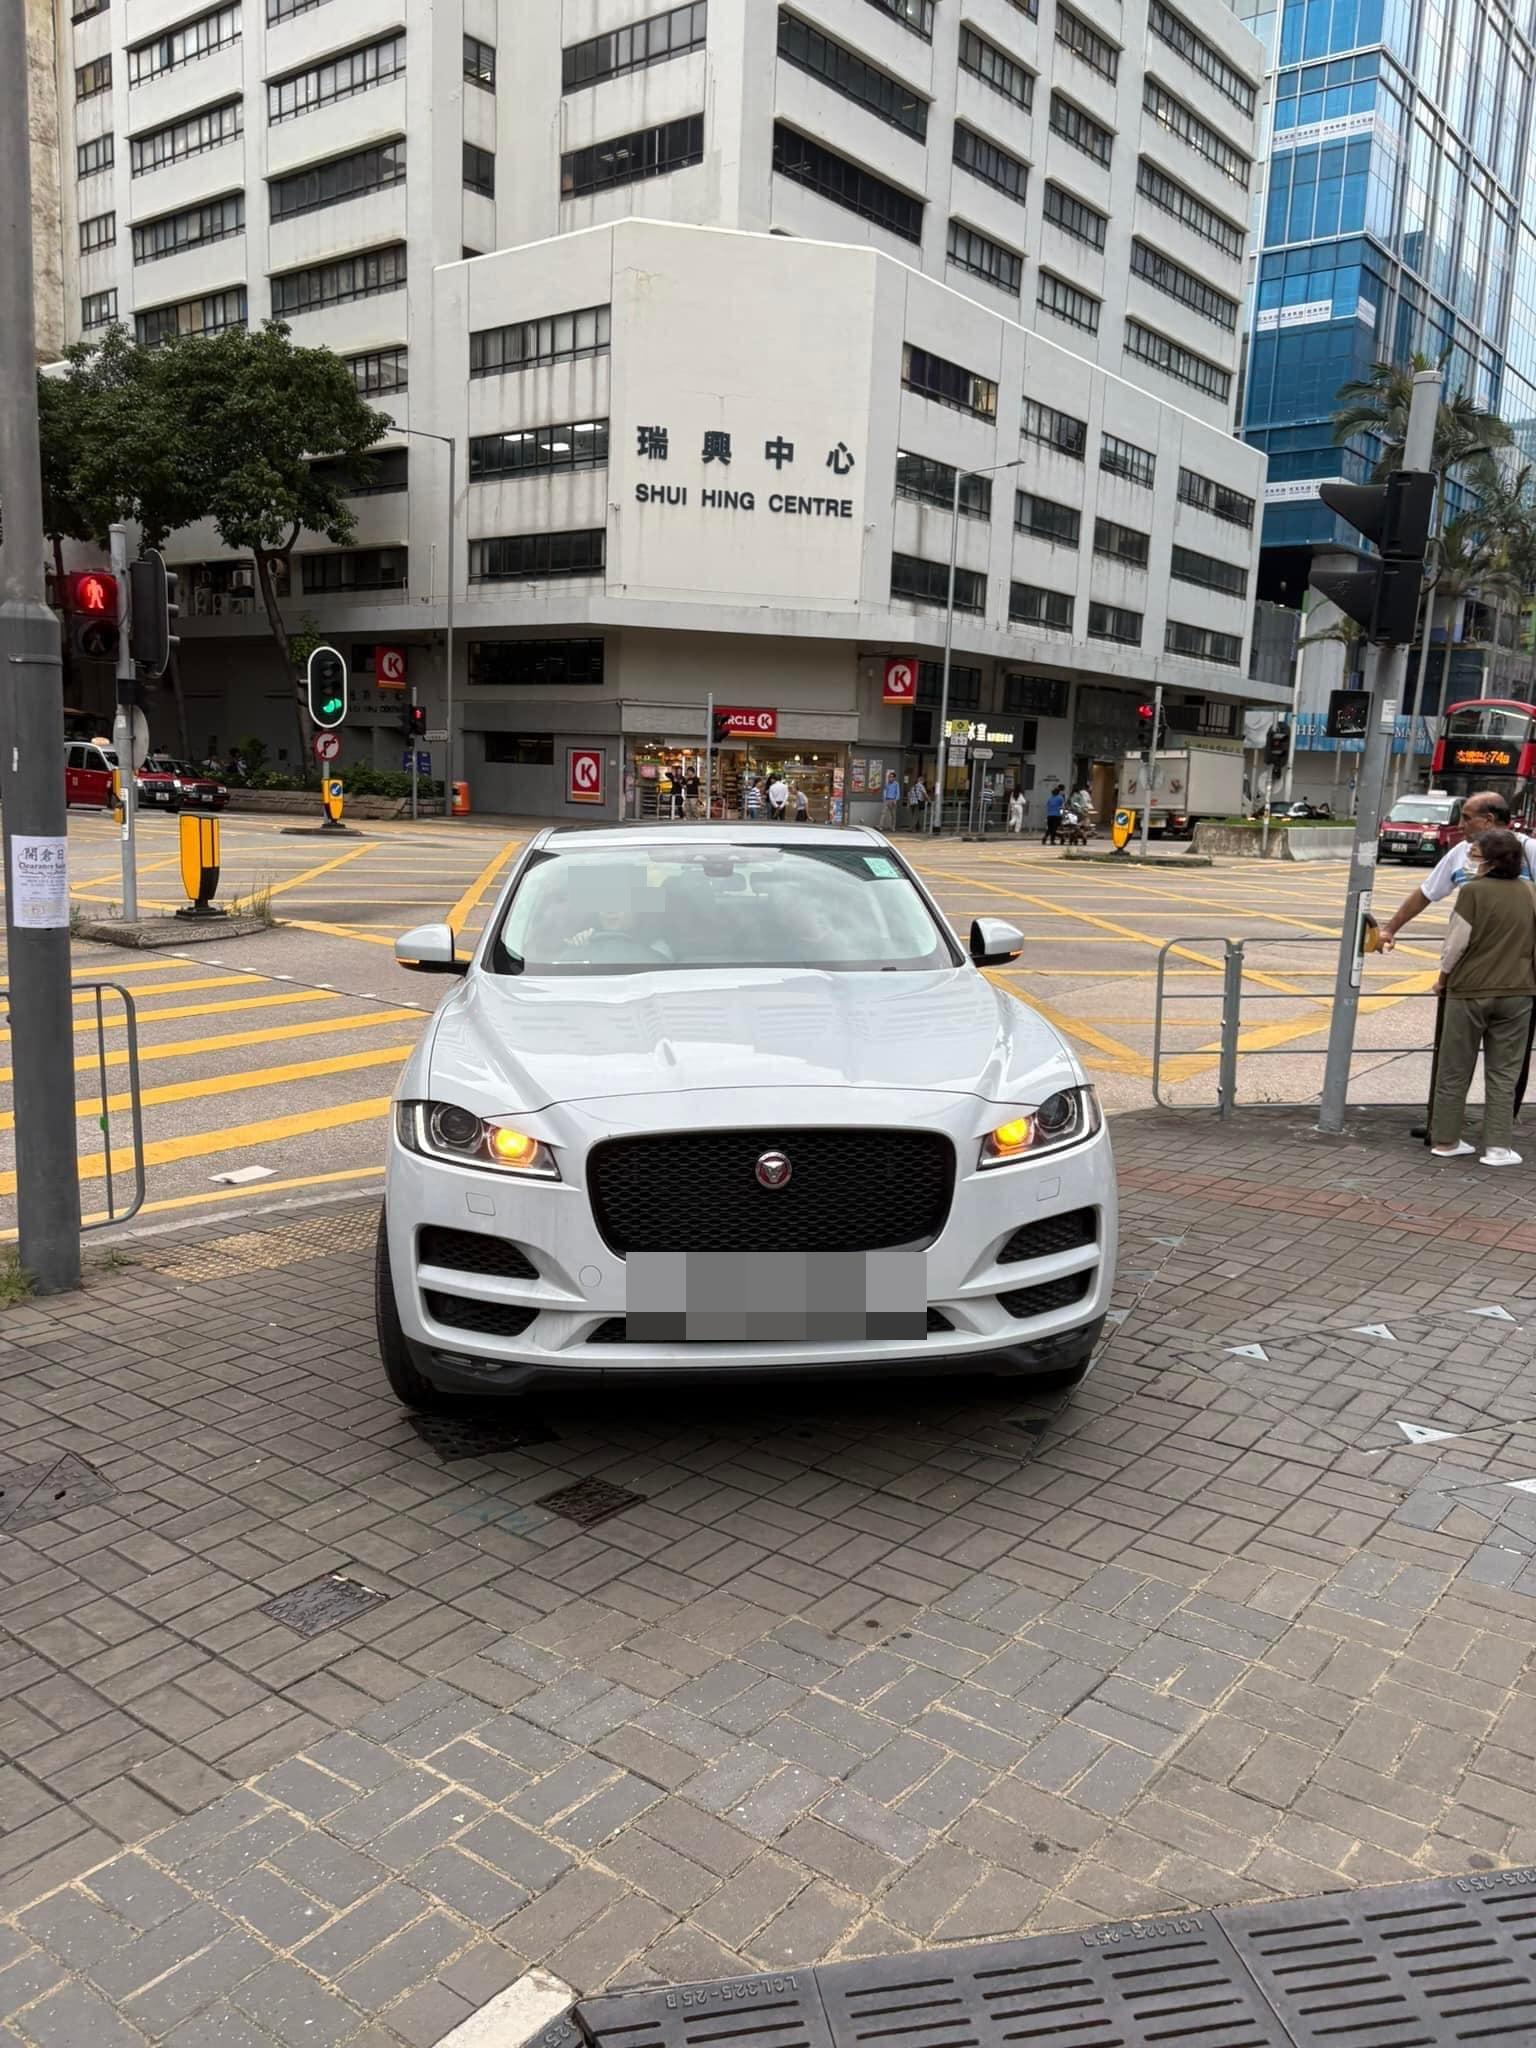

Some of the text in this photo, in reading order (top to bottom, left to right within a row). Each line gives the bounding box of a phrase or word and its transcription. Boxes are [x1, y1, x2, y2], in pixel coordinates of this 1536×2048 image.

[637, 426, 855, 475] 瑞興中心
[635, 484, 853, 517] SHUI HING CENTRE
[725, 714, 772, 729] RCLE K
[1296, 725, 1317, 736] HE
